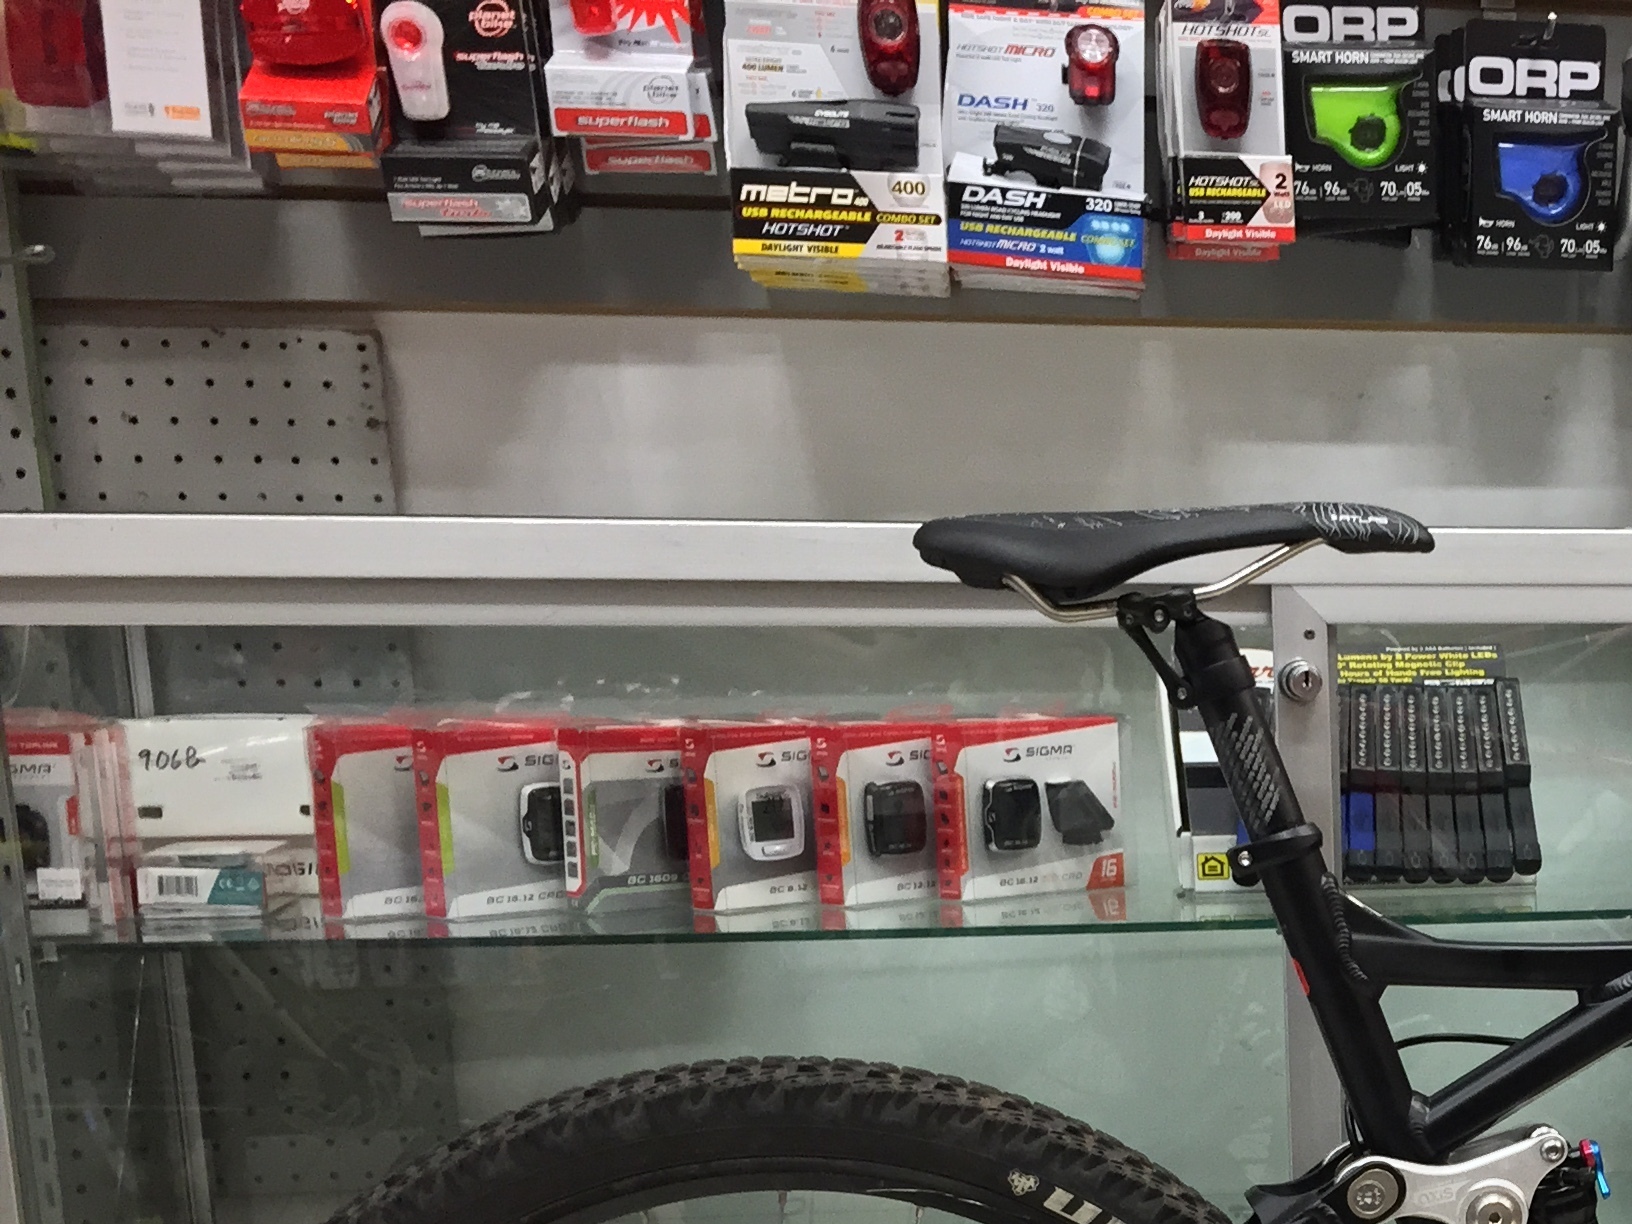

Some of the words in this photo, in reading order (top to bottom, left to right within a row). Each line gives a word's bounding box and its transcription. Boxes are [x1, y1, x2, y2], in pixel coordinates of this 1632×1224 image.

[1181, 24, 1256, 37] HOTSHOT
[1282, 5, 1419, 43] ORP
[1004, 44, 1056, 58] MICRO
[1291, 51, 1333, 64] SMART
[1335, 52, 1369, 64] HORN
[1468, 56, 1601, 98] ORP
[956, 93, 1029, 110] DASH
[577, 115, 670, 129] superflash
[1482, 108, 1523, 122] SMART
[1524, 111, 1558, 124] HORN
[1395, 164, 1414, 172] LIGHT
[1188, 175, 1251, 187] HOTSHOT
[1274, 173, 1288, 190] 2
[739, 181, 854, 205] metro
[891, 181, 926, 196] 400
[1205, 187, 1267, 198] RECHARGEABLE
[1324, 181, 1340, 196] 96
[1380, 181, 1397, 196] 70
[961, 185, 1047, 209] DASH
[1085, 197, 1113, 213] 320
[742, 206, 768, 219] USB
[770, 207, 872, 222] RECHARGEABLE
[875, 213, 916, 224] COMBO
[918, 214, 936, 224] SET
[761, 220, 843, 237] HOTSHOT
[1495, 219, 1515, 228] HORN
[1575, 222, 1594, 231] LIGHT
[960, 221, 984, 233] USB
[985, 224, 1077, 243] RECHARGEABLE
[1204, 228, 1243, 240] Daylight
[1245, 229, 1277, 239] Visible
[761, 242, 804, 254] DAYLIGHT
[806, 243, 840, 254] VISIBLE
[1476, 234, 1492, 250] 76
[1506, 236, 1522, 250] 96
[1560, 238, 1576, 253] 70
[1585, 239, 1600, 254] 05
[1005, 256, 1048, 271] Daylight
[1049, 261, 1086, 275] Visible
[1337, 653, 1379, 661] Lumens
[1380, 653, 1393, 662] by
[1404, 652, 1437, 660] Power
[1438, 652, 1469, 660] White
[1470, 651, 1499, 660] LEDs
[1348, 661, 1393, 670] Rotating
[1395, 661, 1443, 670] Magnetic
[1444, 660, 1466, 669] Clip
[1339, 670, 1371, 678] Hours
[1372, 669, 1383, 677] of
[1385, 669, 1418, 677] Hands
[1419, 669, 1443, 677] Free
[1444, 668, 1486, 677] Lighting
[1026, 744, 1073, 758] SIGMA
[1101, 858, 1118, 877] 16
[627, 874, 646, 885] BC
[999, 877, 1015, 887] BC
[486, 894, 505, 905] BC
